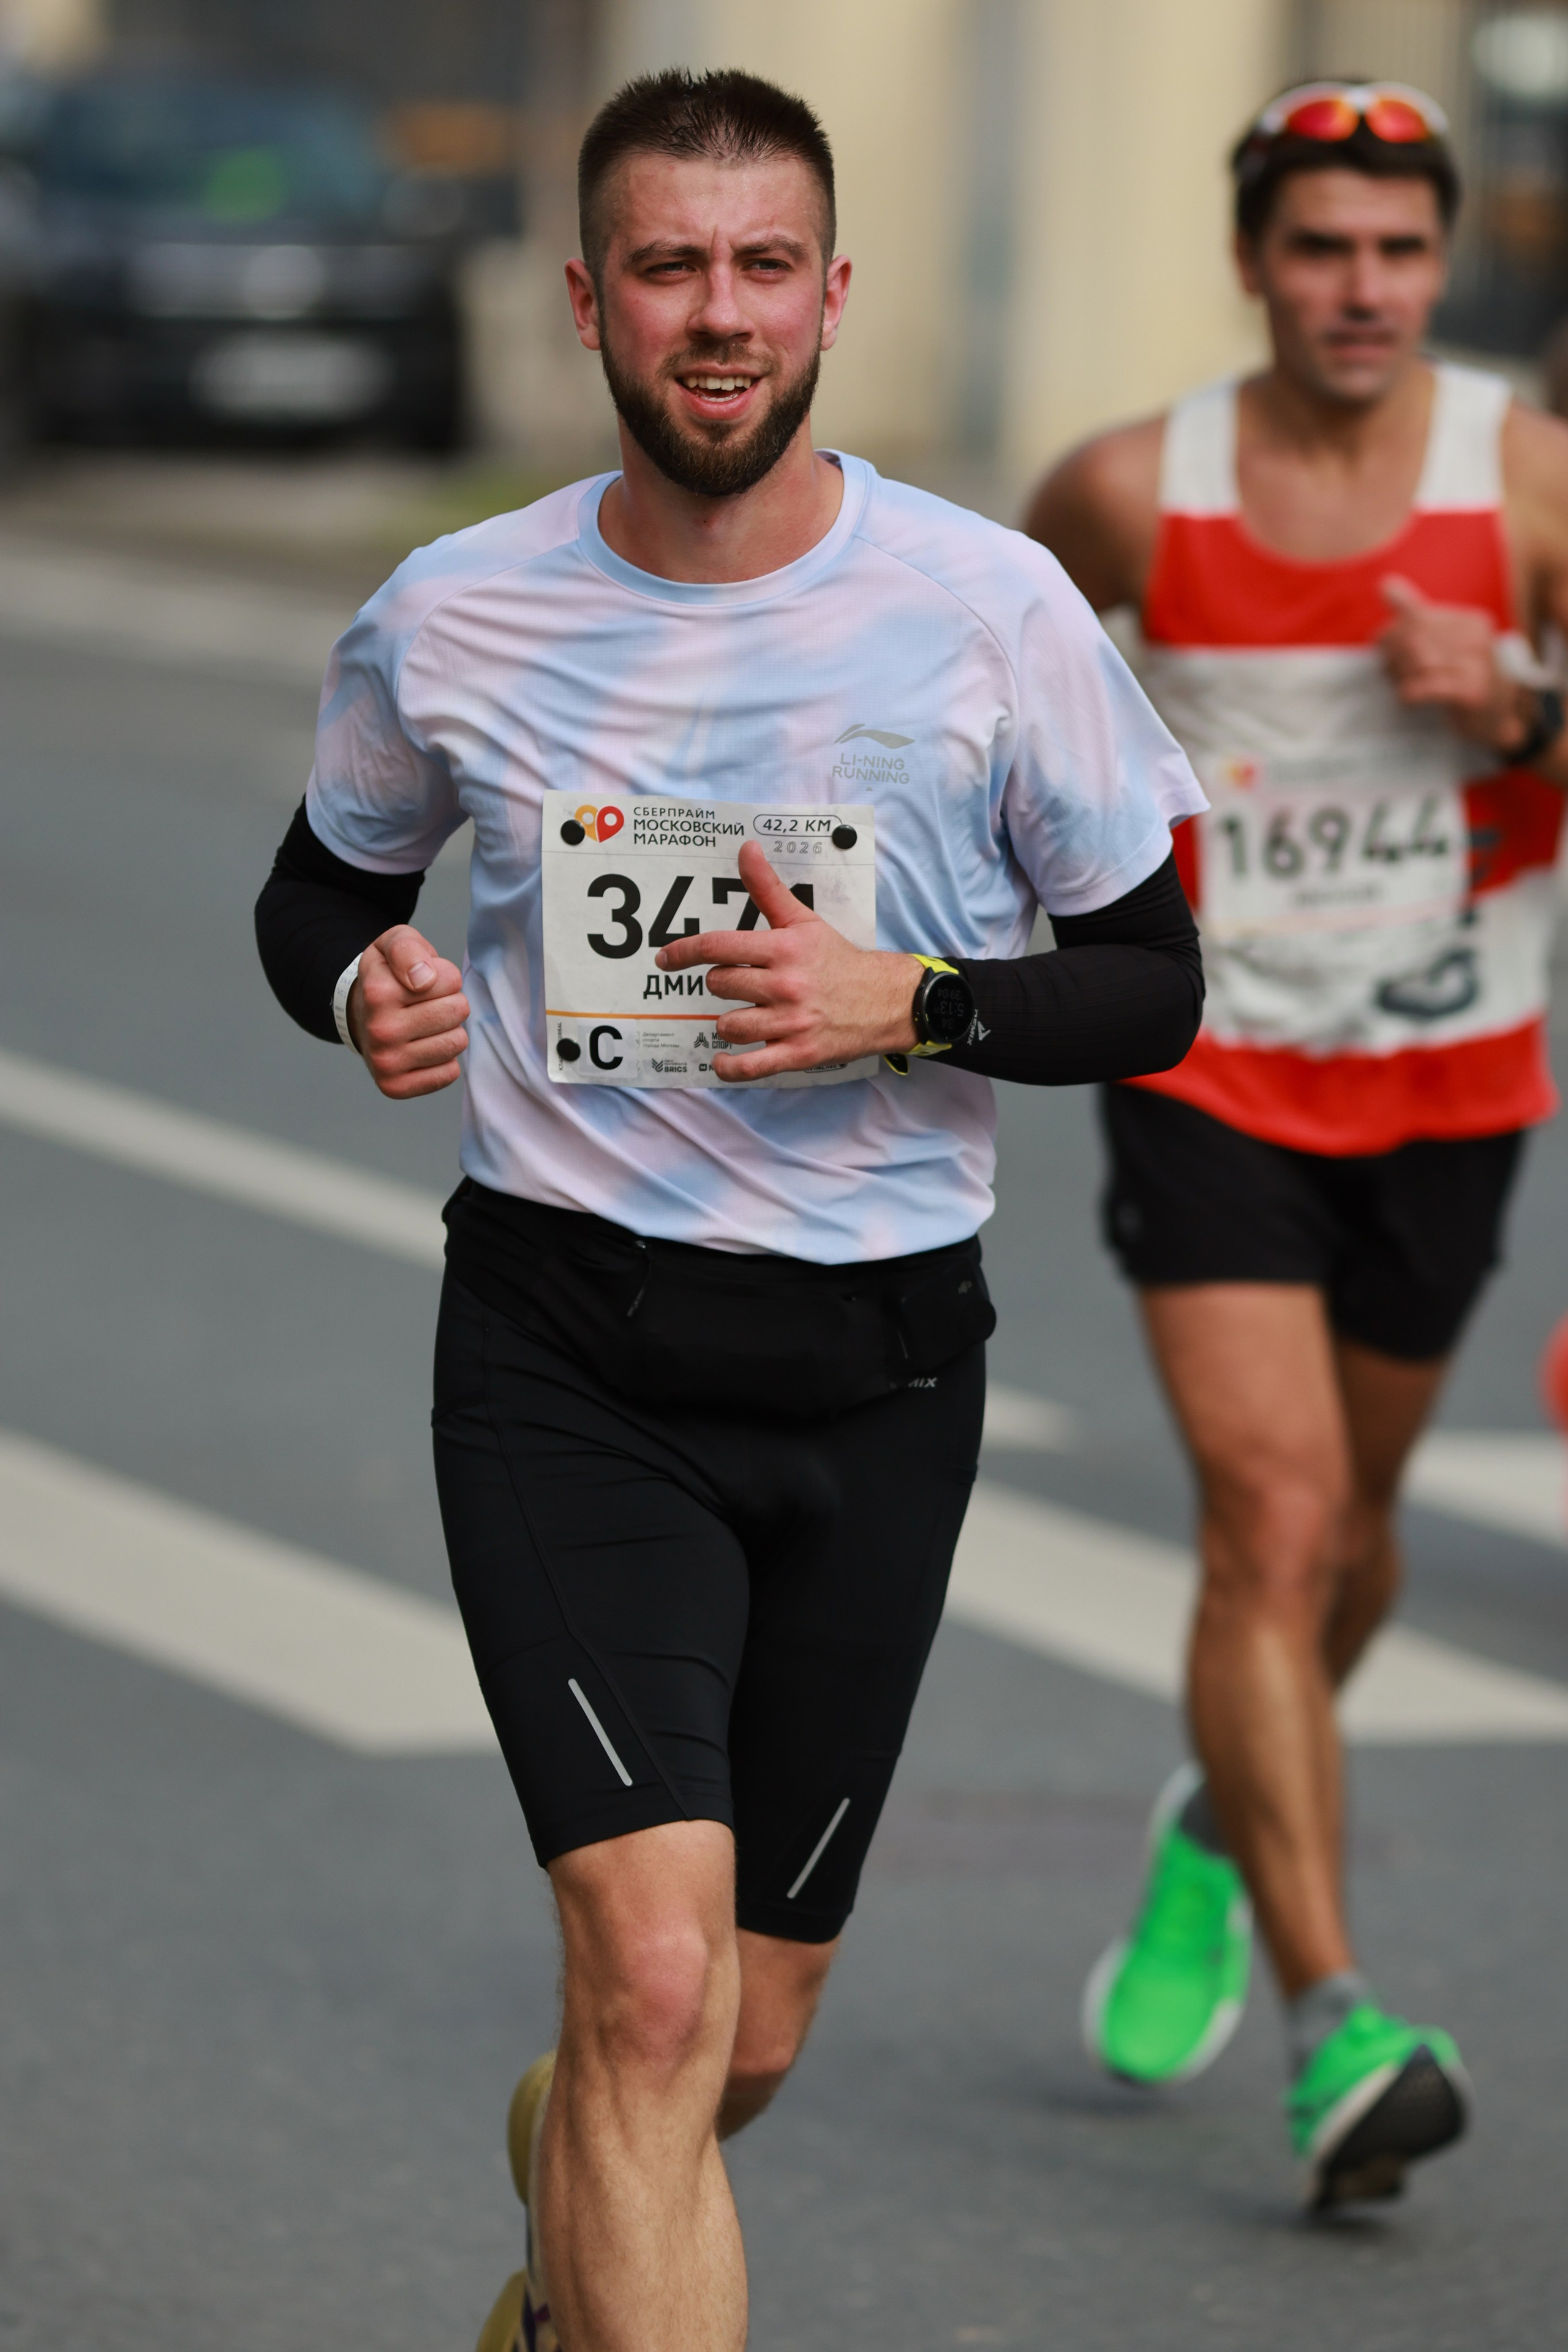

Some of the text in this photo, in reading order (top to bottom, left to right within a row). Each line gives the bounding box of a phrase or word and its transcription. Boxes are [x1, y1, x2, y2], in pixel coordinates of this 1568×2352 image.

[840, 753, 905, 771] LI-NING
[832, 765, 910, 785] RUNNING
[633, 807, 715, 820] СБЕРПРАЙМ
[633, 819, 745, 836] МОСКОВСКИЙ
[763, 818, 831, 834] 42,2 КМ
[633, 833, 716, 847] МАРАФОН
[1216, 793, 1449, 880] 16944
[773, 840, 823, 854] 2026
[643, 974, 715, 1000] ДМИ
